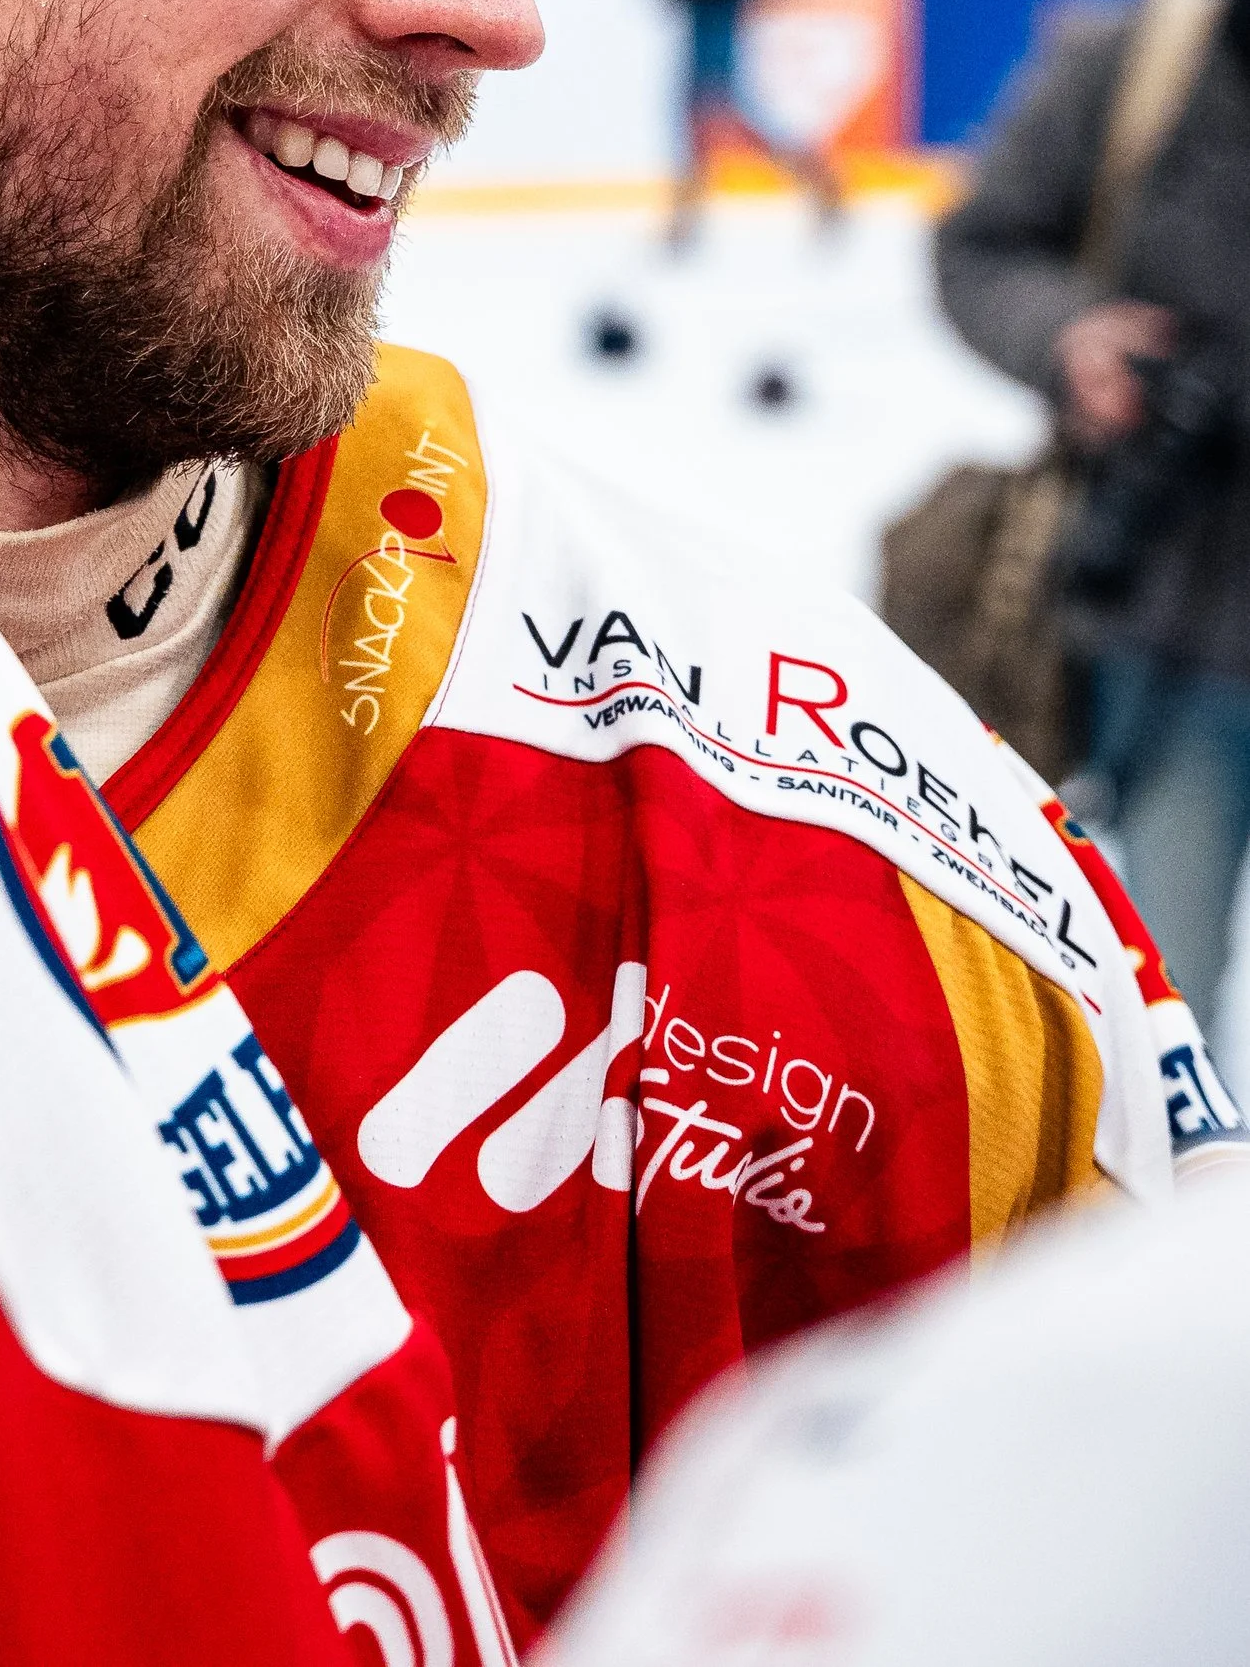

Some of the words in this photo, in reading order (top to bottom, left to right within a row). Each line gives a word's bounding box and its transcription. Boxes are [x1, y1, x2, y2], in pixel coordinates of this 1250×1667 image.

[521, 609, 702, 706] VAN
[776, 775, 900, 832] SANITAIR
[930, 842, 1054, 948] ZWEMBAD
[642, 984, 876, 1154] design
